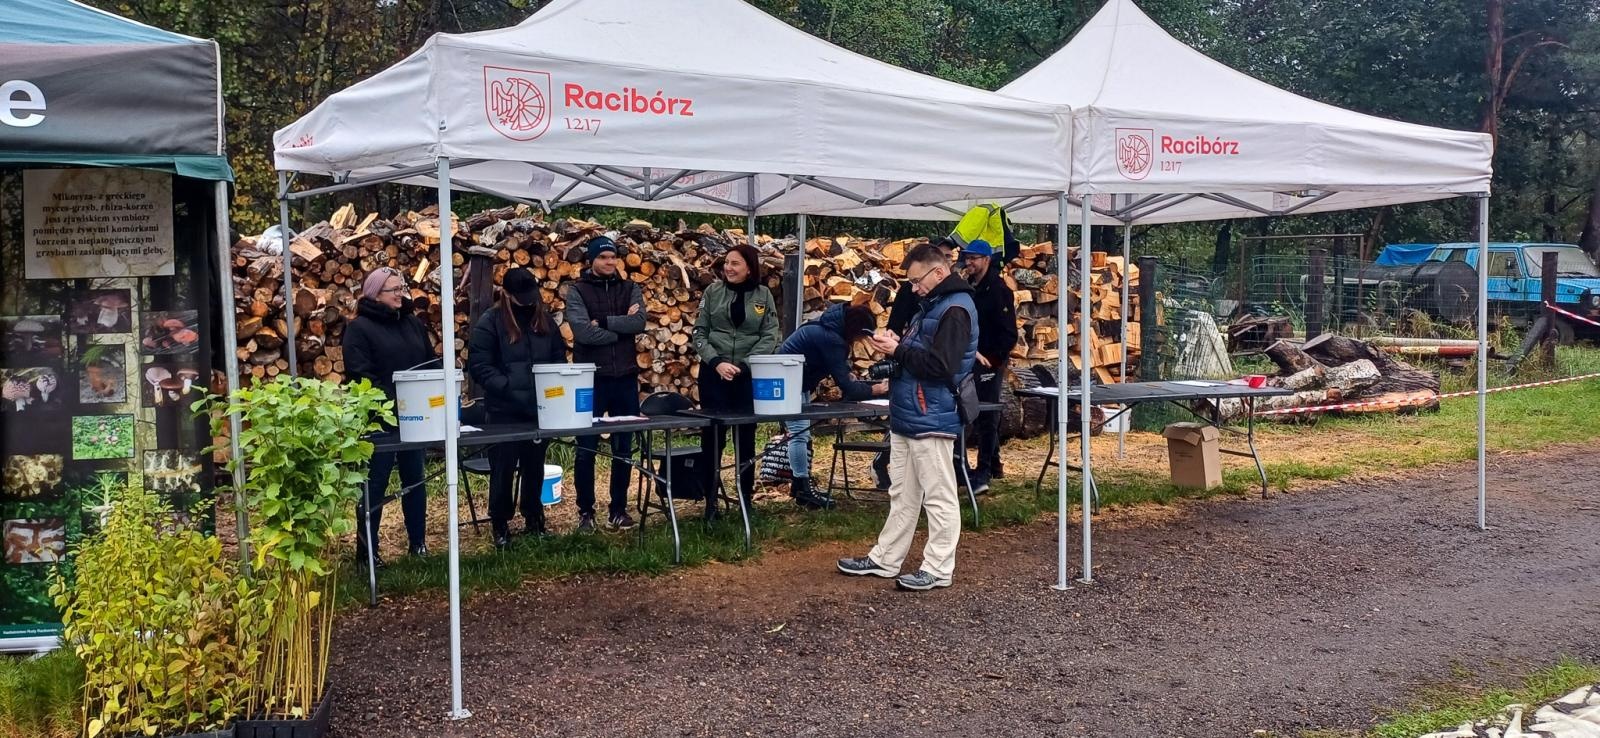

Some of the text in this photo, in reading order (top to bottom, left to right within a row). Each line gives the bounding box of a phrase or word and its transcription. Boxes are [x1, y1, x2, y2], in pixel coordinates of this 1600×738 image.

[565, 83, 694, 117] Racibórz
[564, 117, 601, 137] 1217
[1161, 135, 1239, 155] Racibórz
[1160, 161, 1182, 174] 1217
[105, 191, 146, 202] greckiego
[112, 213, 150, 223] symbiozy
[111, 223, 159, 233] komórkami
[36, 237, 69, 246] korzeni
[36, 248, 77, 258] grzybami
